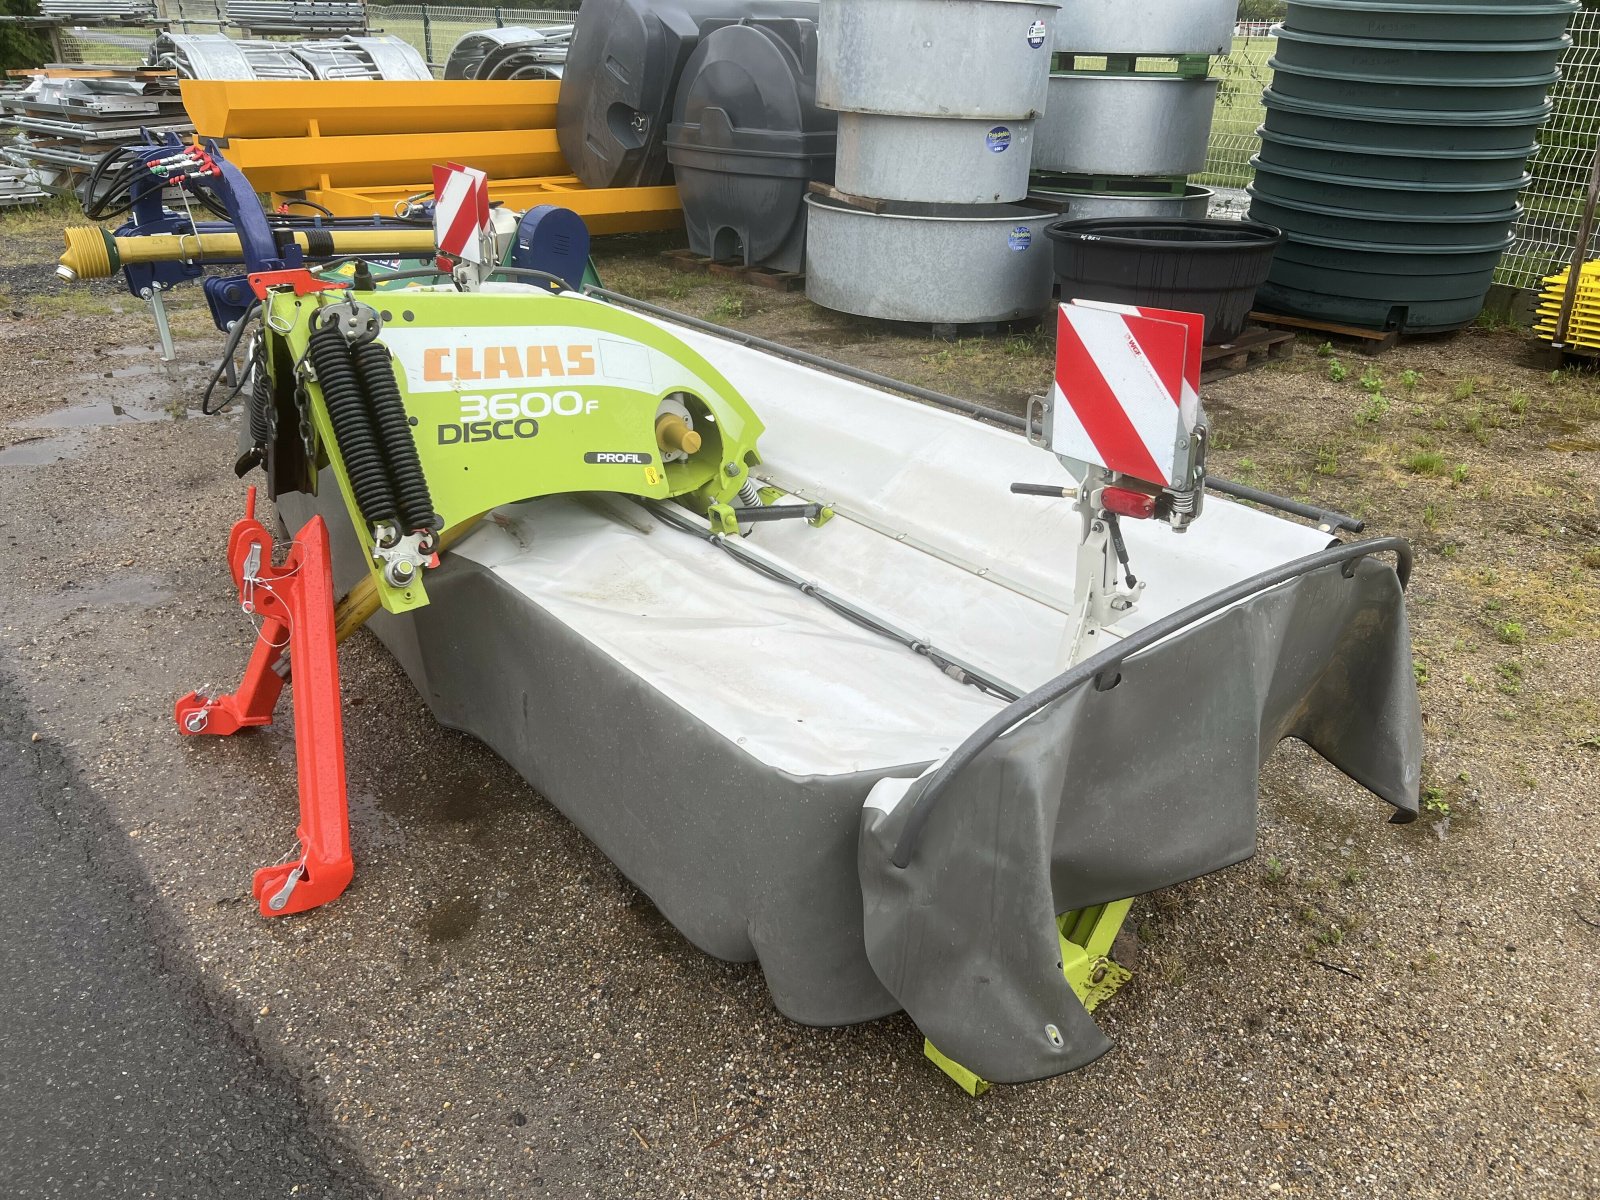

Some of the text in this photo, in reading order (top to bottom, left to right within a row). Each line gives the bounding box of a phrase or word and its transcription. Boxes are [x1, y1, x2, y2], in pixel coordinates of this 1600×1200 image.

[423, 345, 595, 381] CLAAS
[438, 419, 539, 445] DISCO
[597, 453, 641, 463] PROFIL
